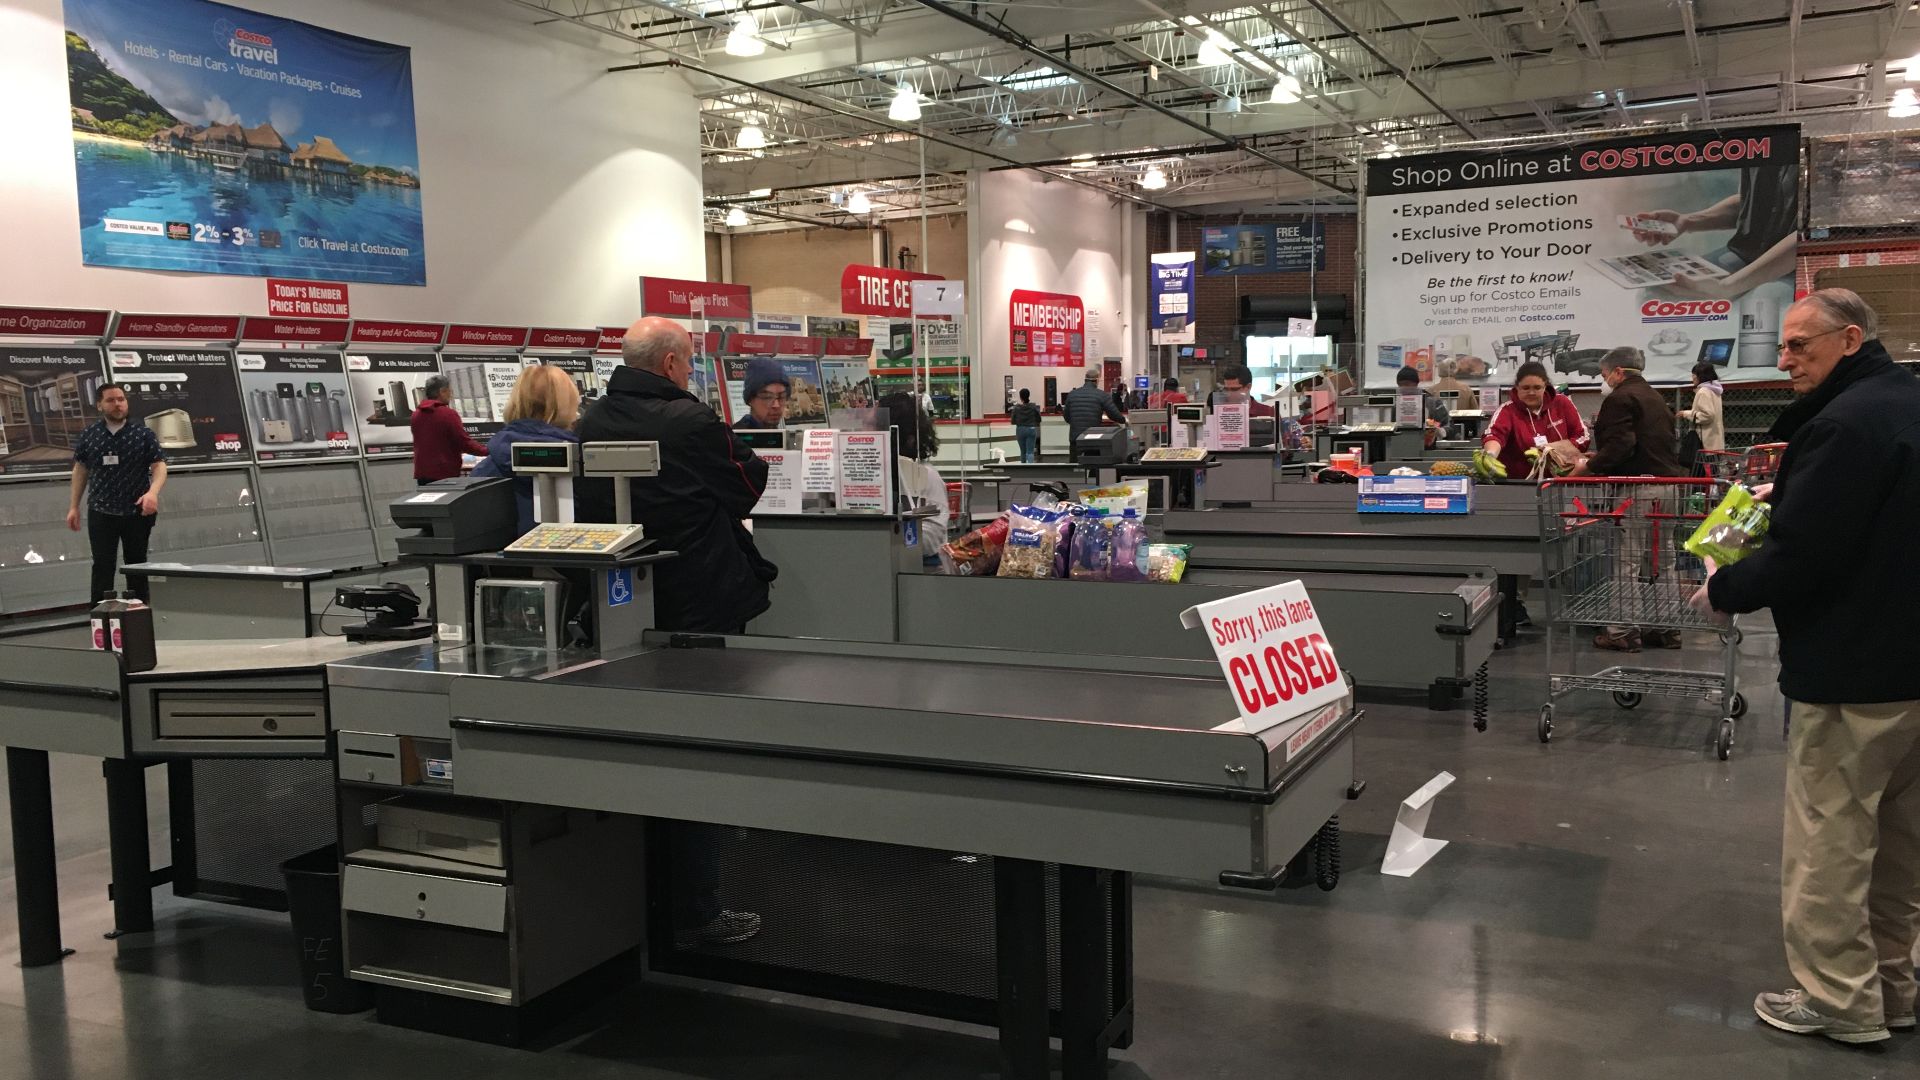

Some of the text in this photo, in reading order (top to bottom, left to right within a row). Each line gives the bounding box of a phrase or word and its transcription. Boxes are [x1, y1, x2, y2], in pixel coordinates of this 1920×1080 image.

[235, 28, 272, 46] COSTCO
[229, 39, 278, 64] travel
[124, 40, 362, 98] Hotels Rental Cars Vacation Packages Cruises
[1392, 136, 1771, 187] Shop Online at COSTCO.COM
[1402, 193, 1578, 218] Expanded selection
[194, 223, 220, 242] 2%
[1276, 226, 1300, 238] FREE
[1402, 218, 1593, 240] Exclusive Promotions
[298, 236, 409, 256] Click Travel at Costco.com
[1402, 242, 1592, 266] Delivery to Your Door
[1427, 270, 1574, 289] Be the first to know!
[274, 284, 342, 300] TODAY'S MEMBER
[668, 290, 688, 304] Think
[712, 294, 728, 306] First
[858, 276, 912, 308] TIRE CE
[937, 288, 946, 302] 7
[1420, 286, 1582, 305] Sign up for Costco Emails
[270, 299, 348, 315] PRICE FOR GASOLINE
[1432, 302, 1568, 315] Visit the membership counter
[1641, 300, 1731, 316] COSTCO
[0, 316, 86, 330] me Organization
[1014, 302, 1081, 330] MEMBERSHIP
[1424, 318, 1435, 326] Or
[1472, 316, 1502, 324] EMAIL
[1519, 312, 1575, 322] Costco.com
[129, 322, 228, 333] Home Standby Generators
[274, 324, 320, 335] Water Heaters
[357, 327, 438, 340] Heating and Air Conditioning
[1297, 322, 1302, 330] 5
[462, 330, 513, 342] Window Fashions
[544, 334, 586, 346] Custom Flooring
[612, 336, 624, 344] Cente
[10, 356, 86, 364] Discover More Space
[147, 353, 226, 362] Protect What Matters
[596, 360, 612, 368] Photo
[597, 368, 614, 376] Cente
[216, 440, 241, 452] shop
[328, 438, 349, 450] shop
[1212, 599, 1314, 646] Sorry, this lane
[1229, 633, 1338, 714] CLOSED
[313, 972, 332, 1000] 5
